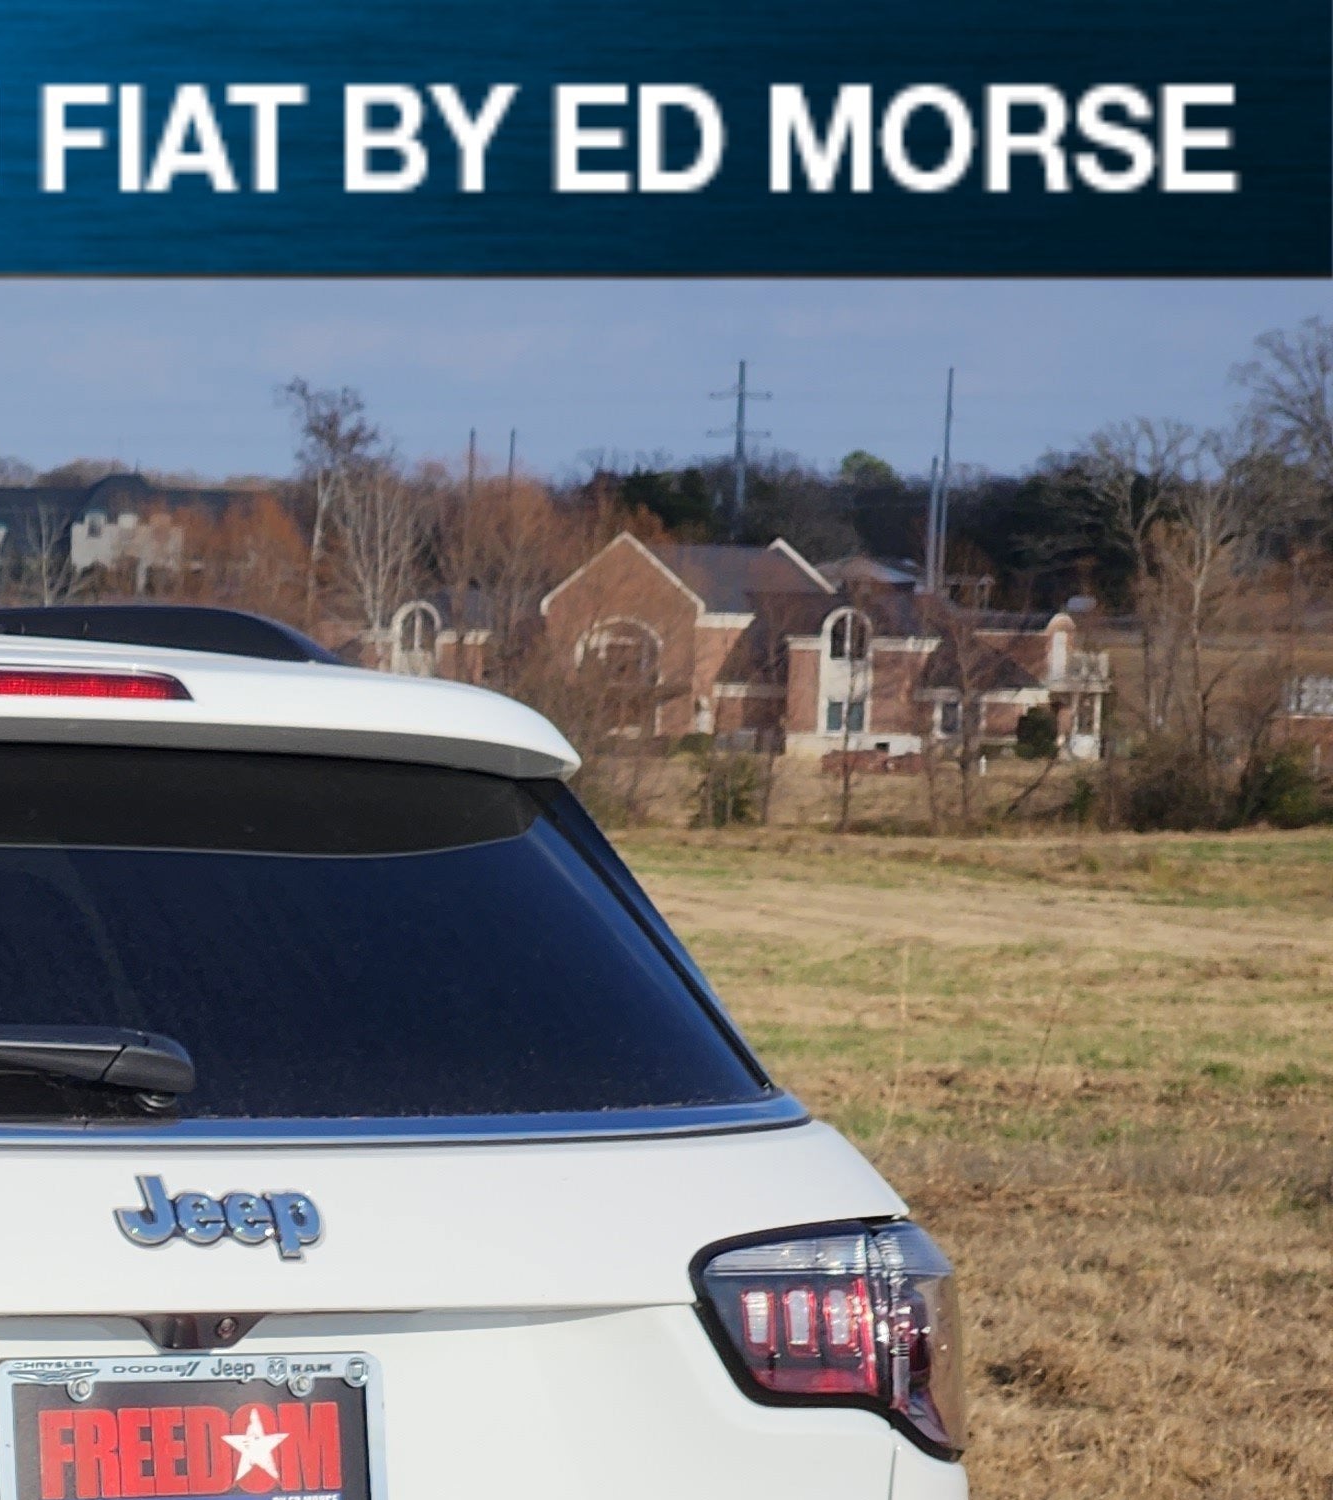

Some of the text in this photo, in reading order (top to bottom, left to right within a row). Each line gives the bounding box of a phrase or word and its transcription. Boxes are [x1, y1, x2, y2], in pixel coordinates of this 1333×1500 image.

[113, 1174, 322, 1261] Jeep
[12, 1357, 333, 1379] CHRYSLER DODGE Jeep RAM
[38, 1401, 343, 1500] FREEDOM
